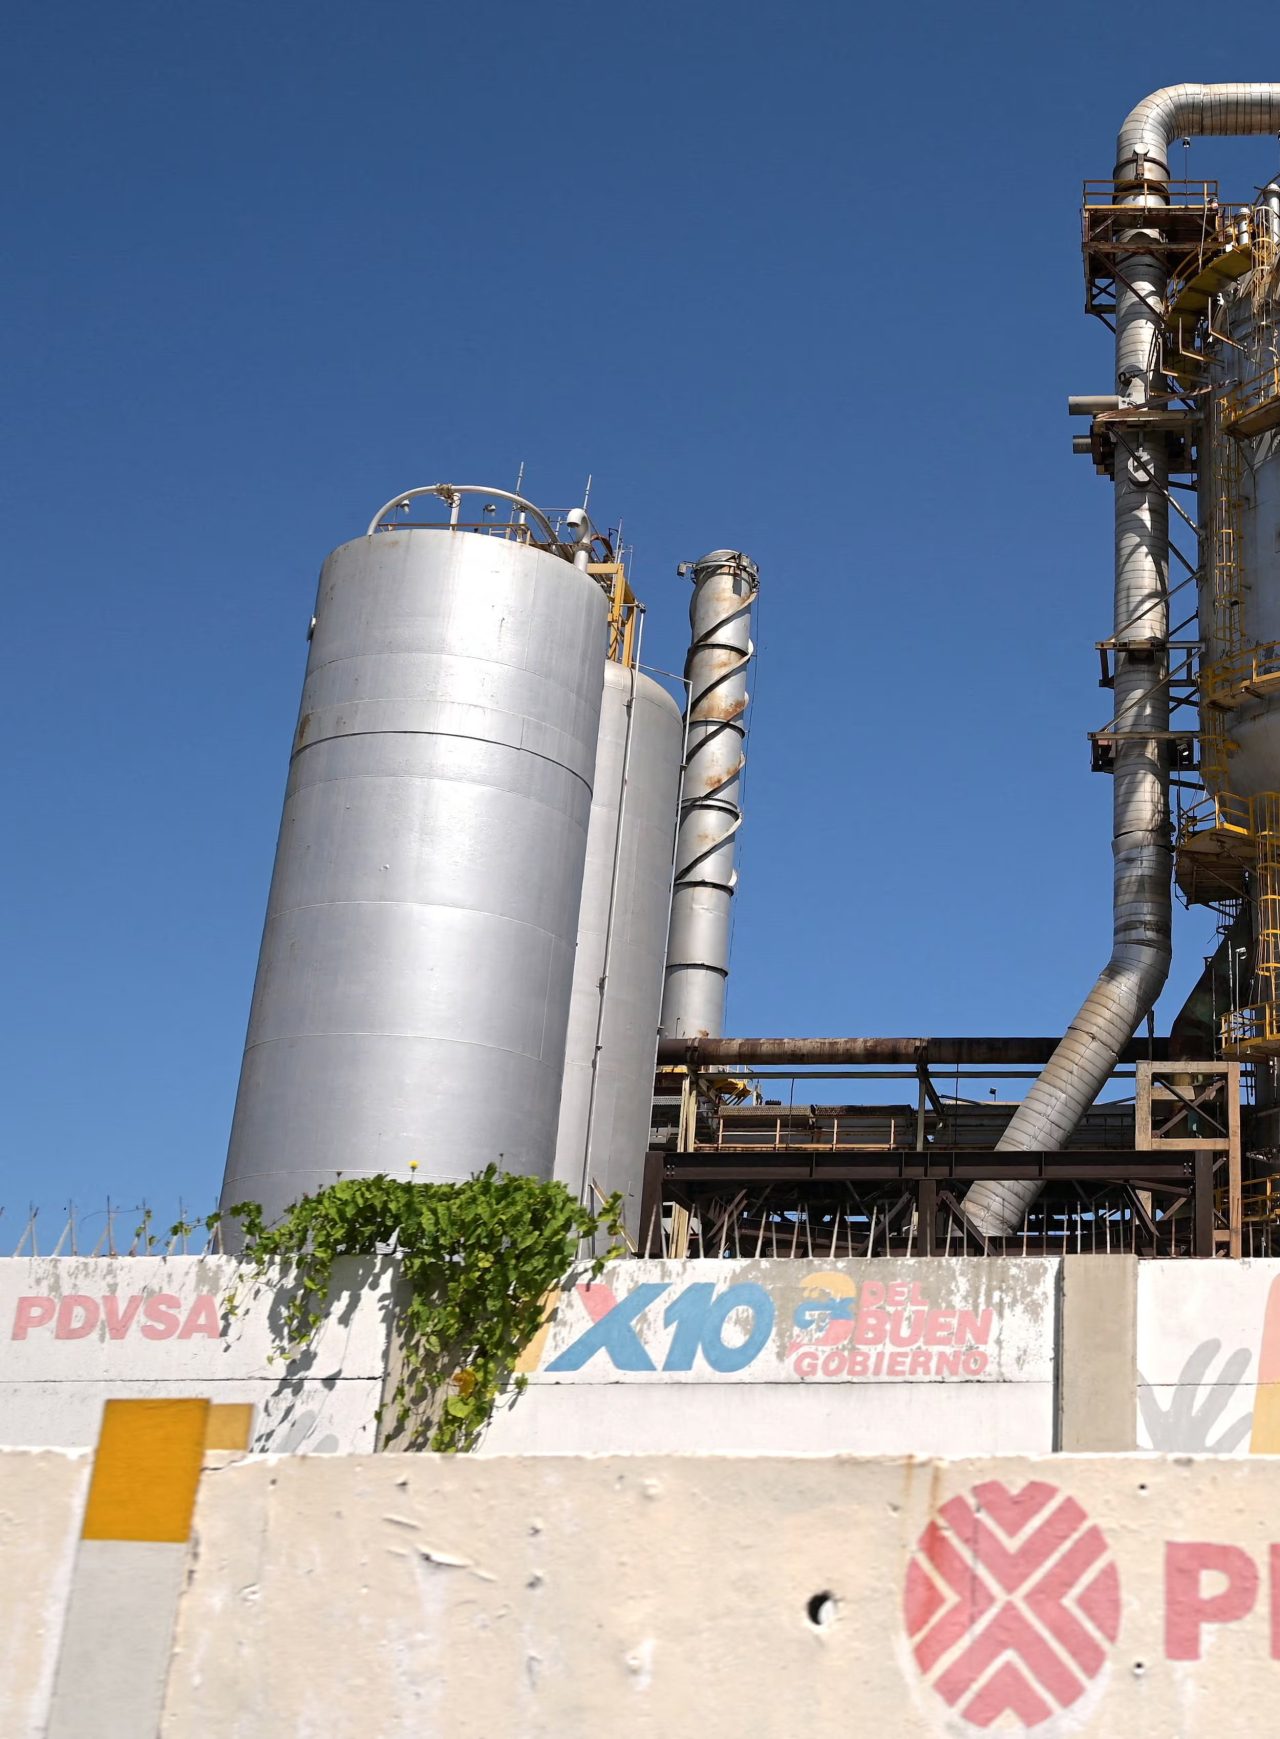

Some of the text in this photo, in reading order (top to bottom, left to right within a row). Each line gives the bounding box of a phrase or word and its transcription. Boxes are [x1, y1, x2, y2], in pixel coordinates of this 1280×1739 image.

[860, 1280, 929, 1307] DEL
[11, 1293, 221, 1341] PDVSA
[855, 1308, 993, 1347] BUEN
[793, 1350, 989, 1377] GOBIERNO
